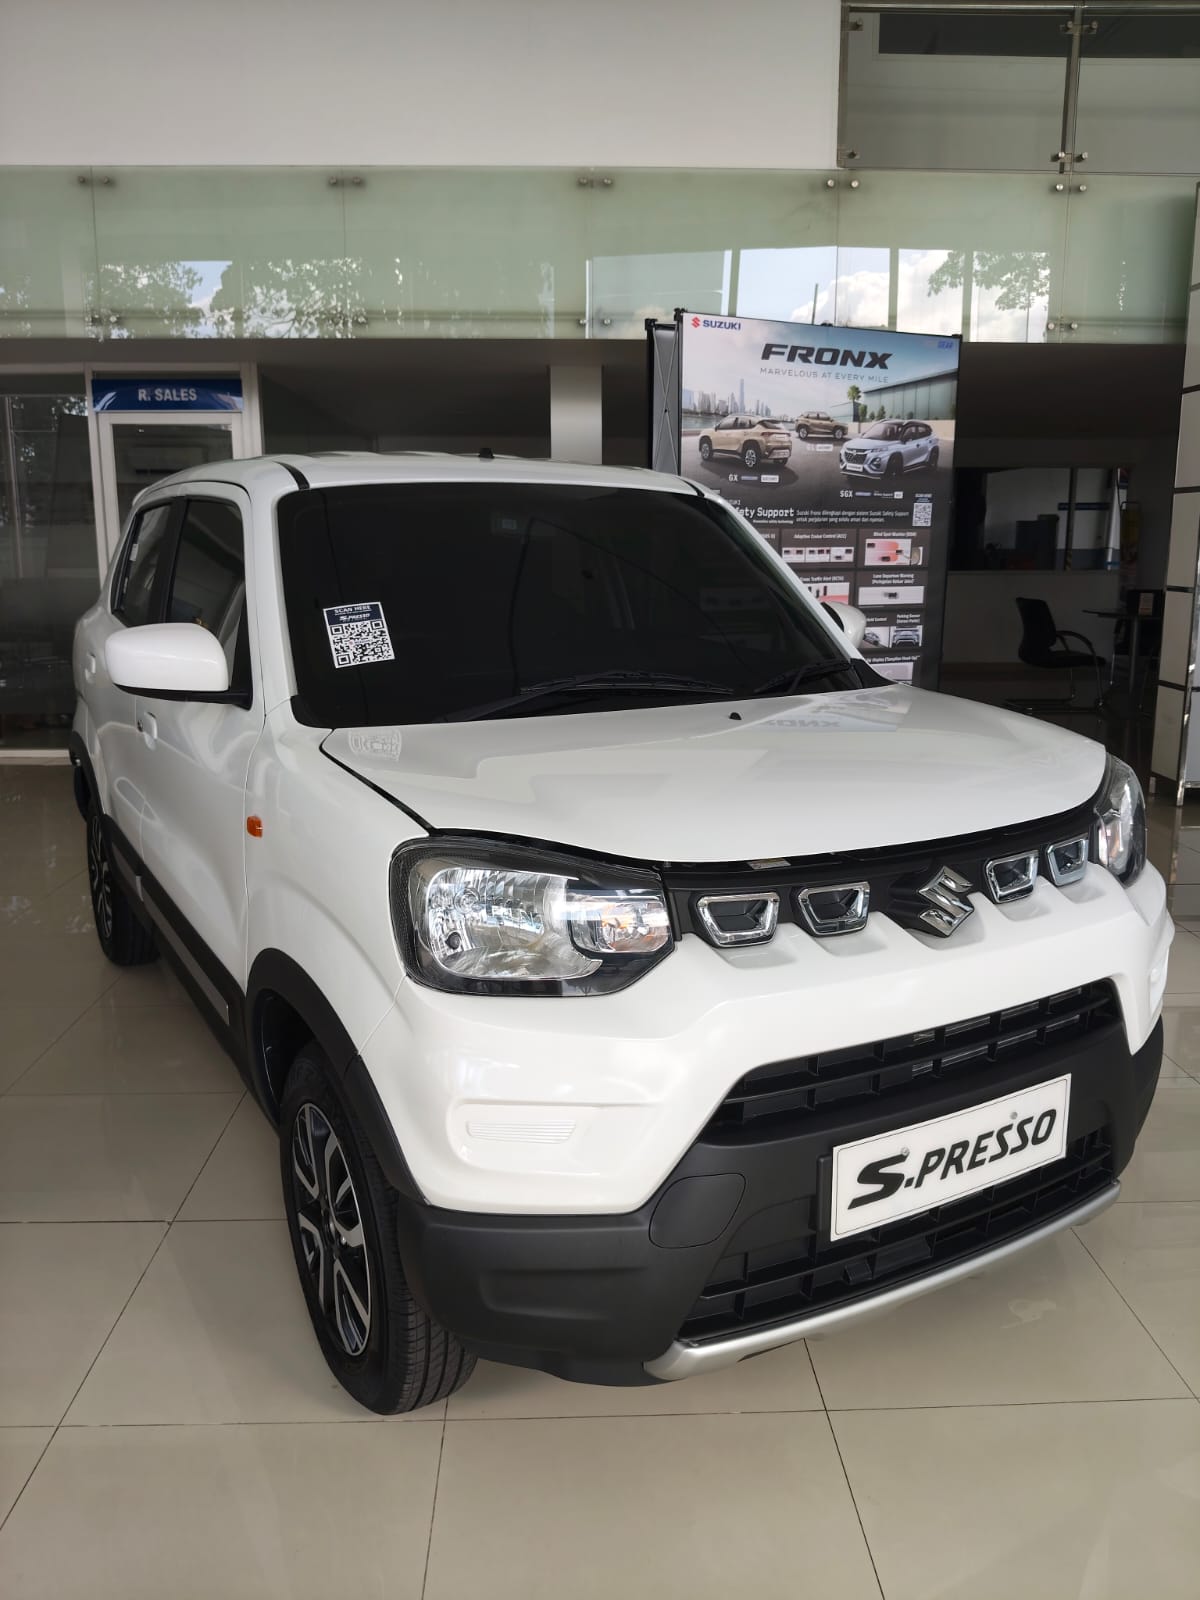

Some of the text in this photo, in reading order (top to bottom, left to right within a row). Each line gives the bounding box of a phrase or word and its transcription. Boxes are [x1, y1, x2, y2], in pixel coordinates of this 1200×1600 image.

[702, 319, 741, 331] SUZUKI
[761, 343, 893, 370] FRONX
[760, 368, 818, 379] MARVELOUS
[835, 373, 865, 382] EVERY
[868, 375, 888, 383] MILE
[138, 388, 197, 401] R. SALES
[735, 506, 794, 518] fety Support
